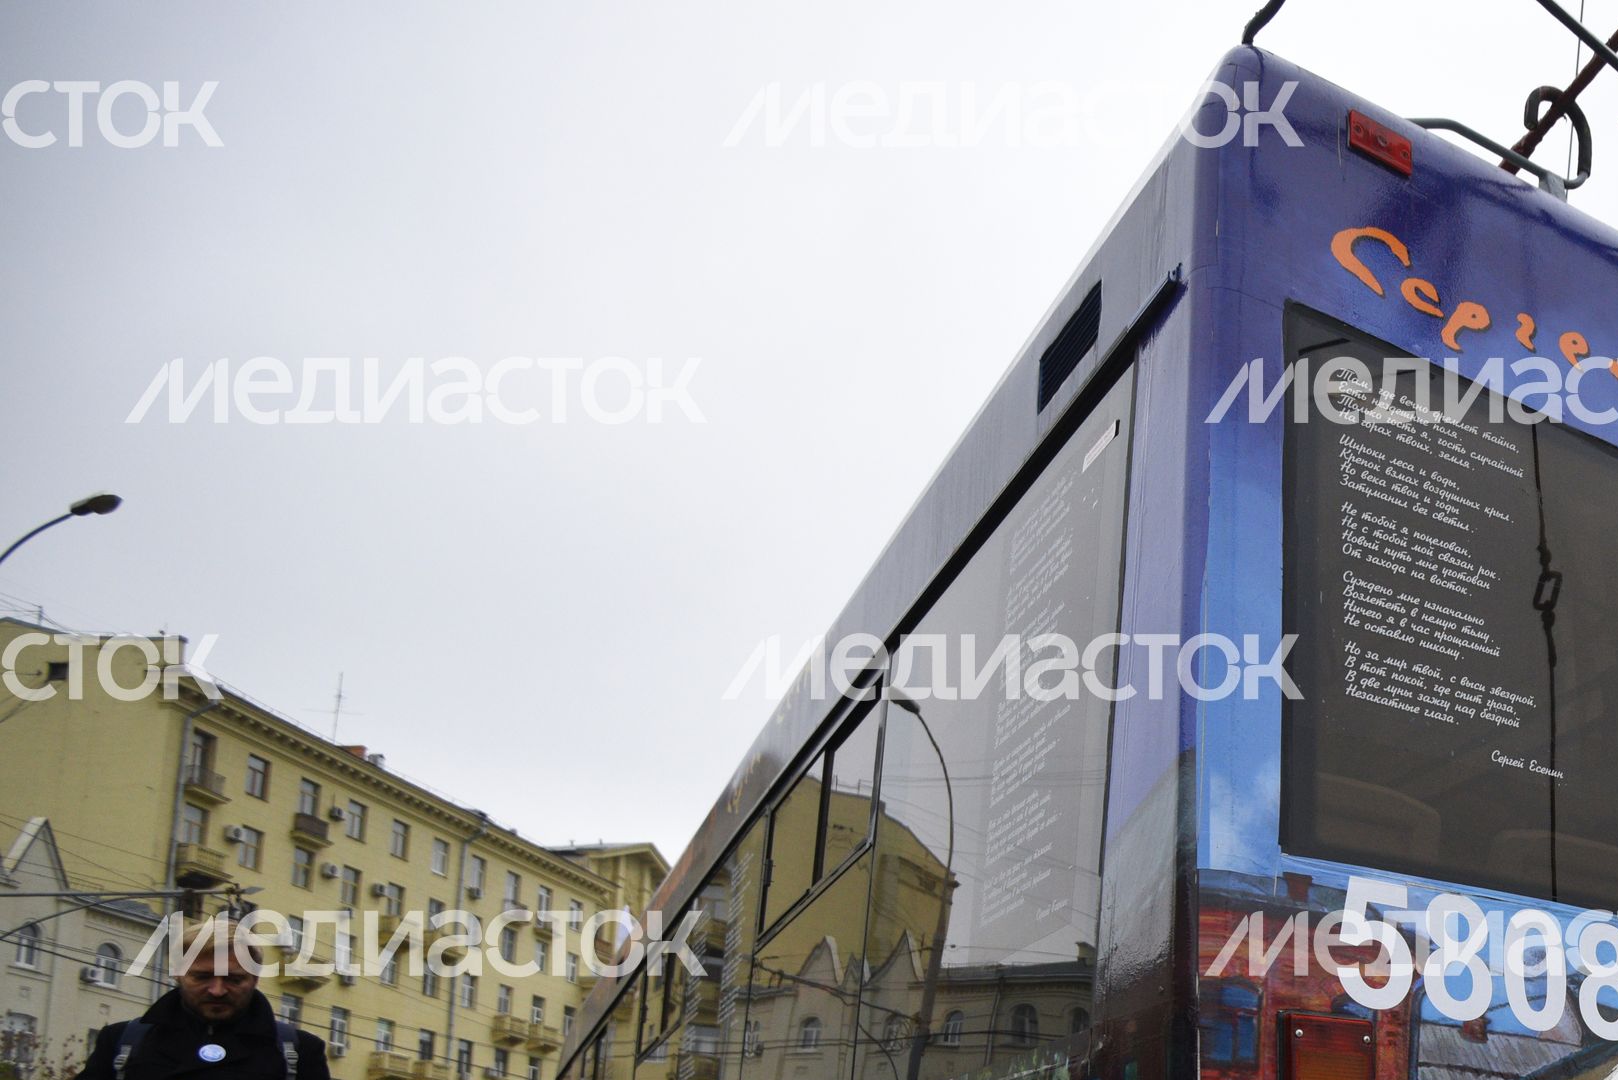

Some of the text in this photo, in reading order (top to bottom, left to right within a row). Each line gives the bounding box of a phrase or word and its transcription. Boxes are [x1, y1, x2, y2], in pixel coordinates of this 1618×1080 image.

[1337, 368, 1519, 454] Там, где вечно дремлет тайна,
[1338, 394, 1524, 478] Только гость я, гость случайный
[1339, 381, 1462, 441] Есть нездешние поля.
[1339, 407, 1474, 470] На горах твоих, земля.
[1339, 434, 1385, 460] Широки
[1389, 458, 1414, 472] леса
[1430, 471, 1460, 490] воды,
[1339, 448, 1514, 523] Крепок взмах воздушных крыл.
[1340, 460, 1356, 475] Но
[1360, 470, 1386, 487] века
[1391, 483, 1419, 499] твои
[1435, 500, 1459, 520] годы
[1340, 474, 1474, 533] Затуманил бег светил.
[1341, 501, 1357, 516] Не
[1361, 512, 1397, 530] тобой
[1413, 531, 1471, 558] поцелован,
[1342, 515, 1358, 530] Не
[1372, 529, 1408, 547] тобой
[1411, 544, 1434, 557] мой
[1438, 552, 1474, 571] связан
[1476, 567, 1500, 581] рок.
[1342, 529, 1490, 589] Новый путь мне уготован
[1342, 543, 1472, 596] От захода на восток.
[1343, 570, 1484, 626] Суждено мне изначально
[1343, 584, 1494, 644] Возлететь в немую тьму.
[1344, 598, 1500, 657] Ничего я в час прощальный
[1344, 612, 1464, 660] Не оставлю никому.
[1344, 655, 1518, 720] В тот покой, где спит гроза,
[1345, 641, 1361, 655] Но
[1365, 651, 1379, 661] за
[1383, 657, 1407, 671] мир
[1412, 664, 1443, 681] твой,
[1460, 676, 1485, 692] выси
[1489, 686, 1536, 708] звездной,
[1345, 670, 1520, 728] В две луны зажгу над бездной
[1345, 683, 1459, 725] Незакатные глаза.
[1491, 750, 1563, 779] Сергей Есенин
